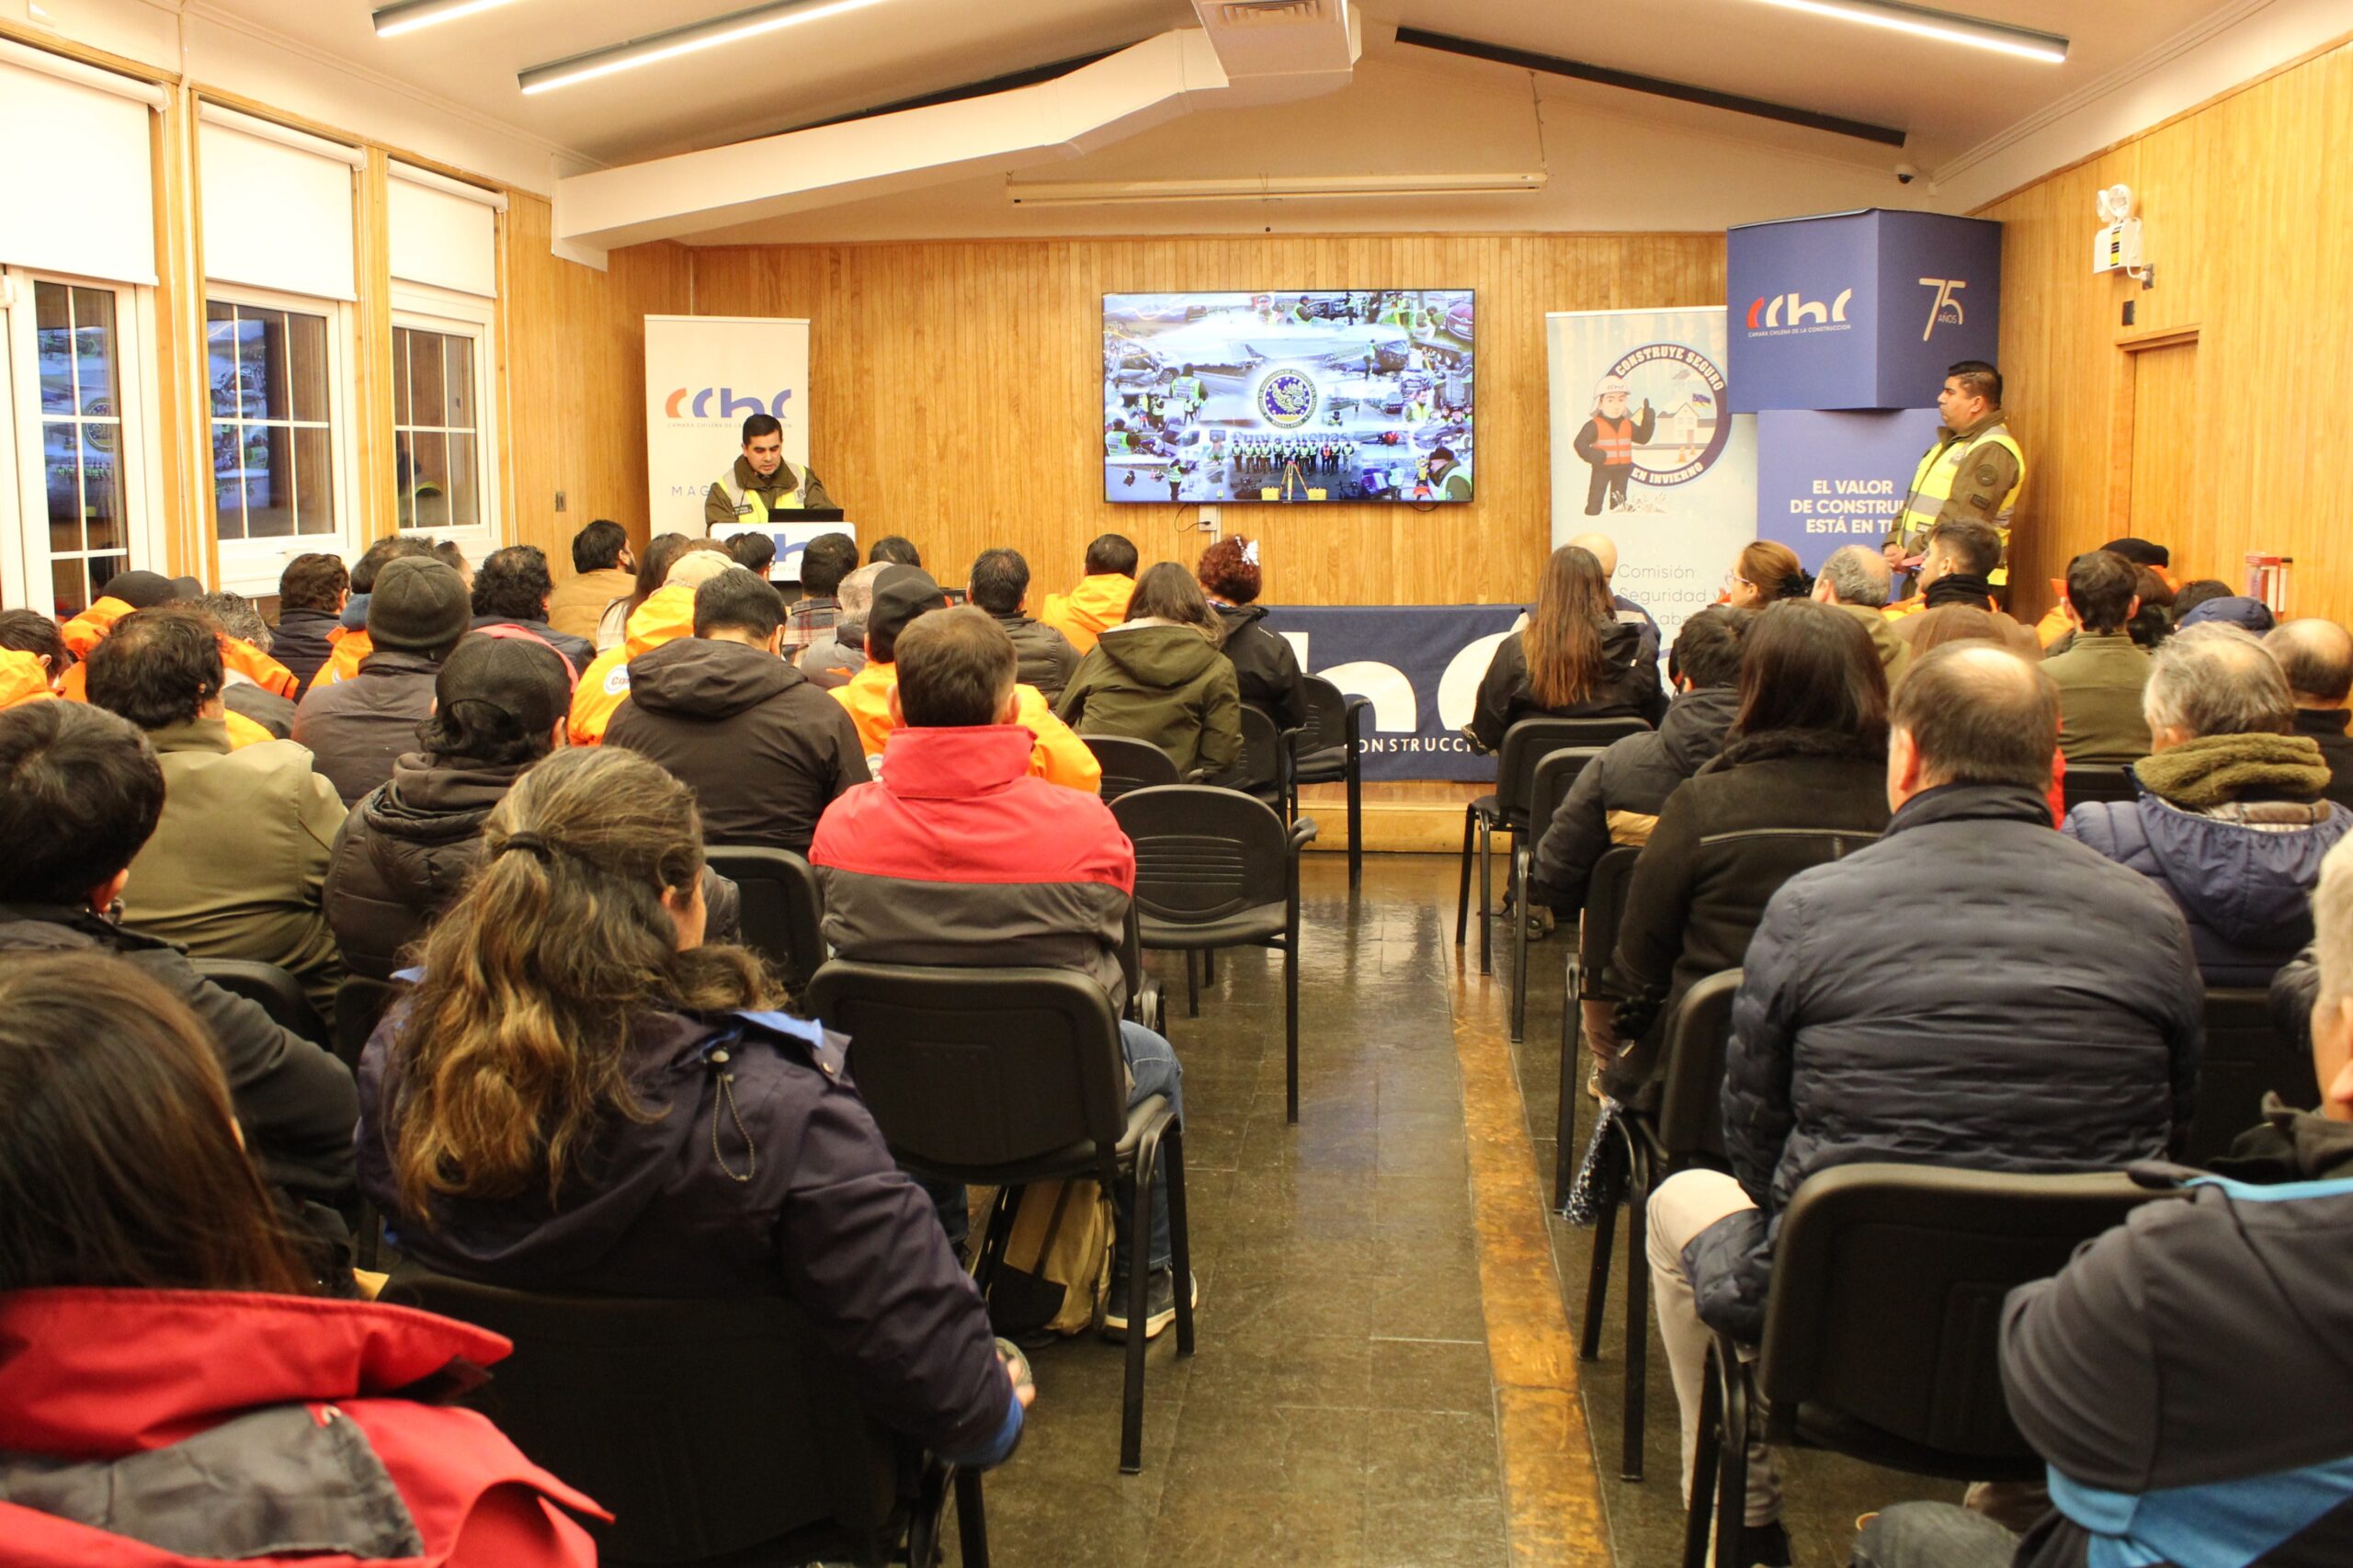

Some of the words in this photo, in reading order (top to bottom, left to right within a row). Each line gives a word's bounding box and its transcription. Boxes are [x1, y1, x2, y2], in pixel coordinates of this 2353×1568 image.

[1918, 278, 1966, 342] 75
[1938, 312, 1958, 324] AÑOS
[1615, 346, 1684, 377] CONSTRUYE
[1686, 351, 1724, 392] SEGURO
[1631, 467, 1647, 483] EN
[1649, 461, 1703, 484] INVIERNO
[1813, 480, 1832, 494] EL
[1835, 480, 1893, 494] VALOR
[1790, 499, 1813, 514] DE
[1816, 499, 1904, 514] CONSTRUI
[1806, 516, 1847, 533] ESTÁ
[1851, 519, 1873, 533] EN
[1618, 563, 1695, 579] Comisión
[1620, 587, 1707, 605] Seguridad
